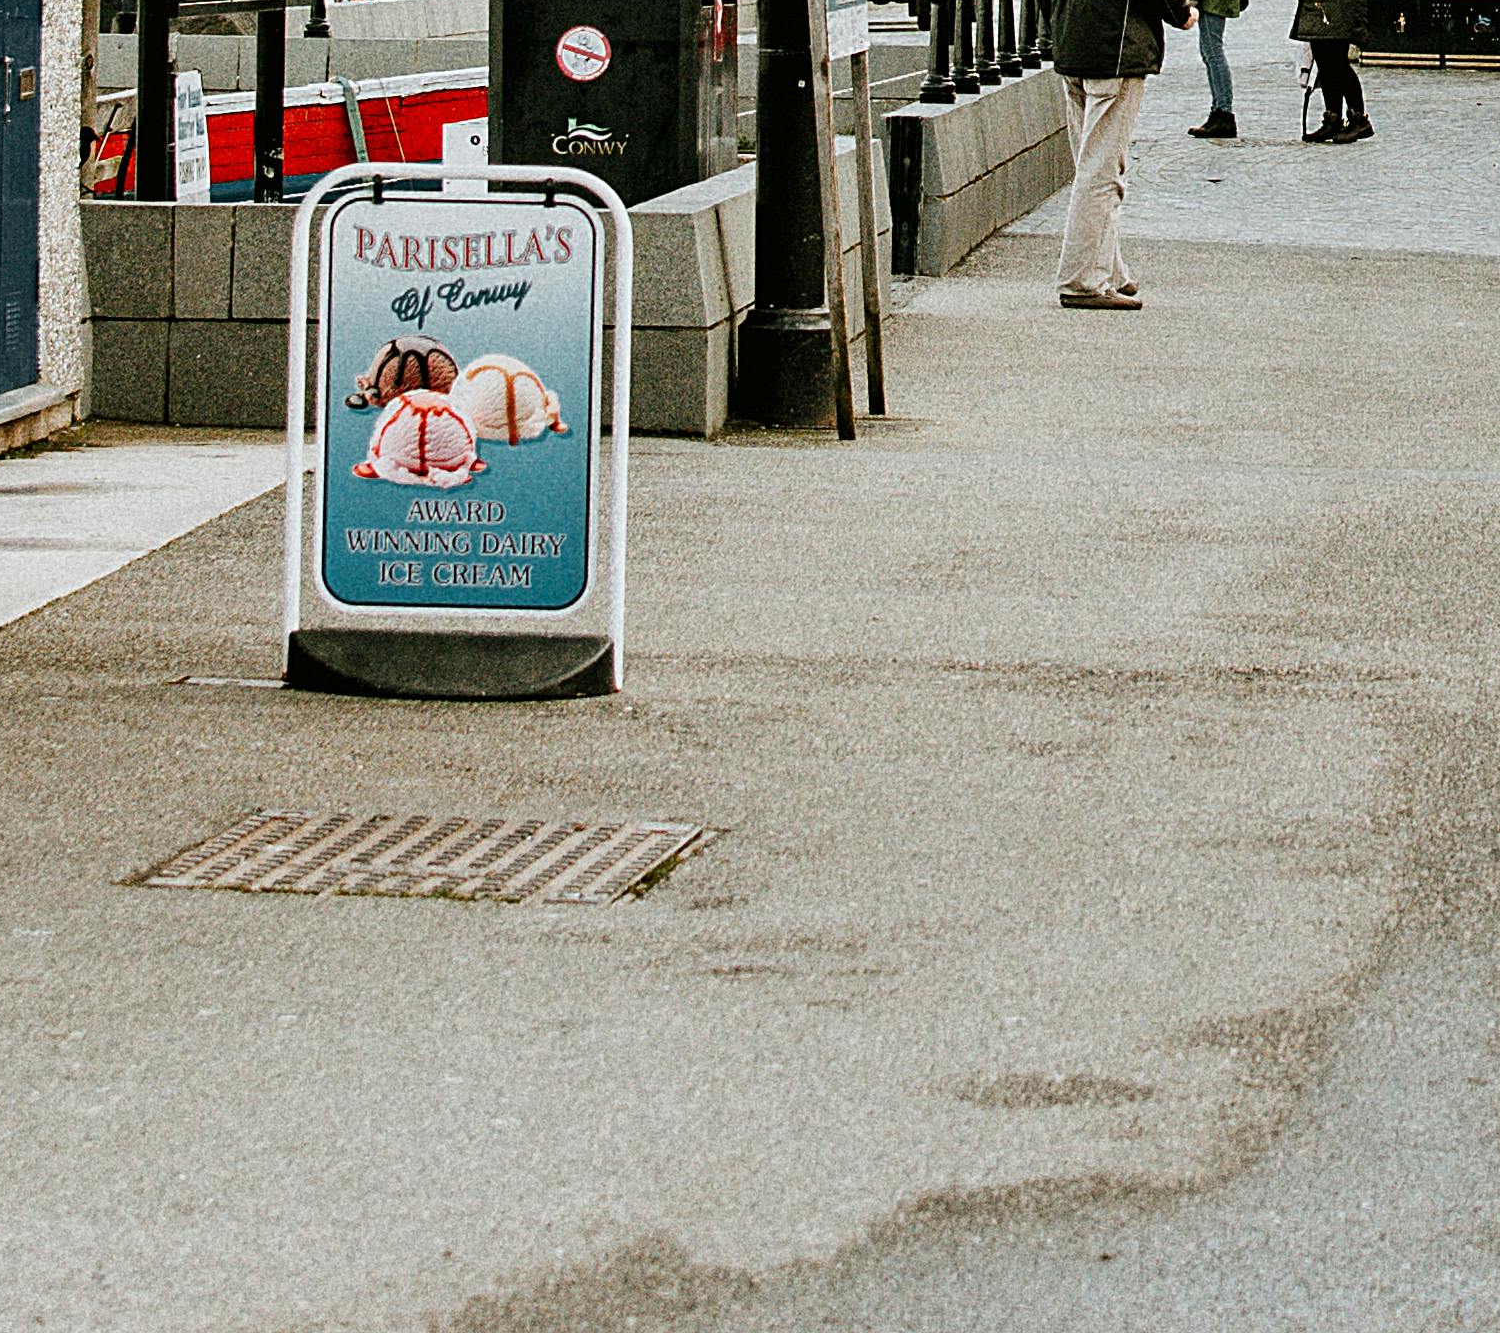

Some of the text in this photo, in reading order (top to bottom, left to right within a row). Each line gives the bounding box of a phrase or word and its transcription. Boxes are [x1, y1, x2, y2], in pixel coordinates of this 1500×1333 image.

[552, 135, 628, 155] CONWY
[353, 223, 574, 272] PARISELLA'S
[391, 277, 533, 331] Of Conwy
[406, 498, 506, 523] AWARD
[345, 528, 567, 557] WINNING DAIRY
[378, 560, 533, 588] ICE CREAM
